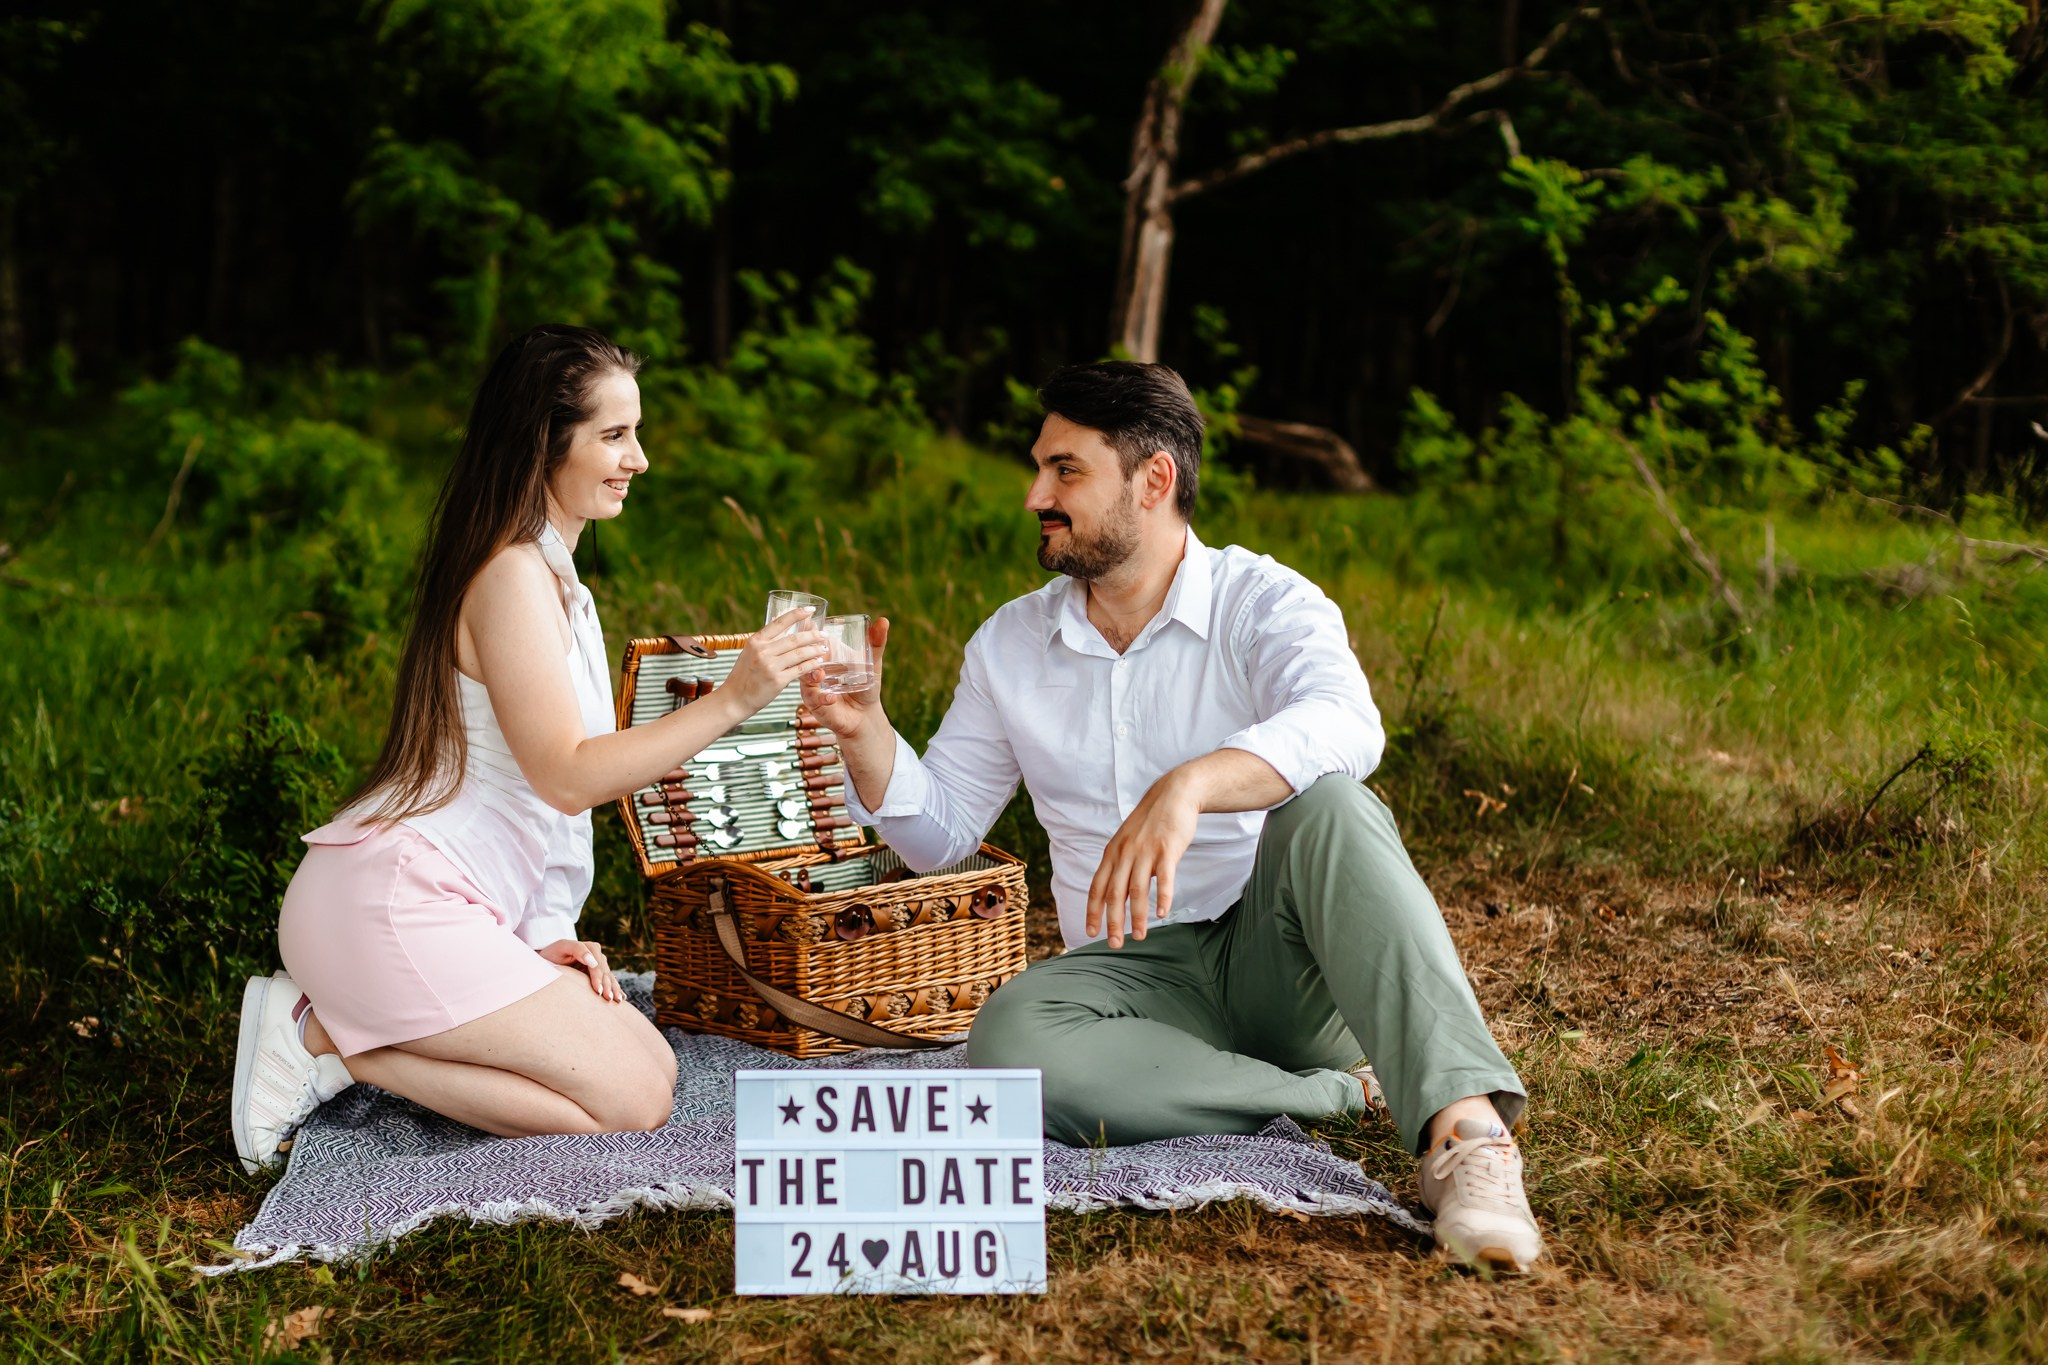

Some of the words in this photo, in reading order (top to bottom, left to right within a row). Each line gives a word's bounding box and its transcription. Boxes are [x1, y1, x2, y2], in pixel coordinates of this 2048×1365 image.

[272, 1050, 294, 1070] SUPERSTAR
[815, 1085, 949, 1133] SAVE
[741, 1158, 839, 1206] THE
[902, 1157, 1034, 1205] DATE
[790, 1231, 851, 1279] 24
[900, 1229, 998, 1279] AUG
